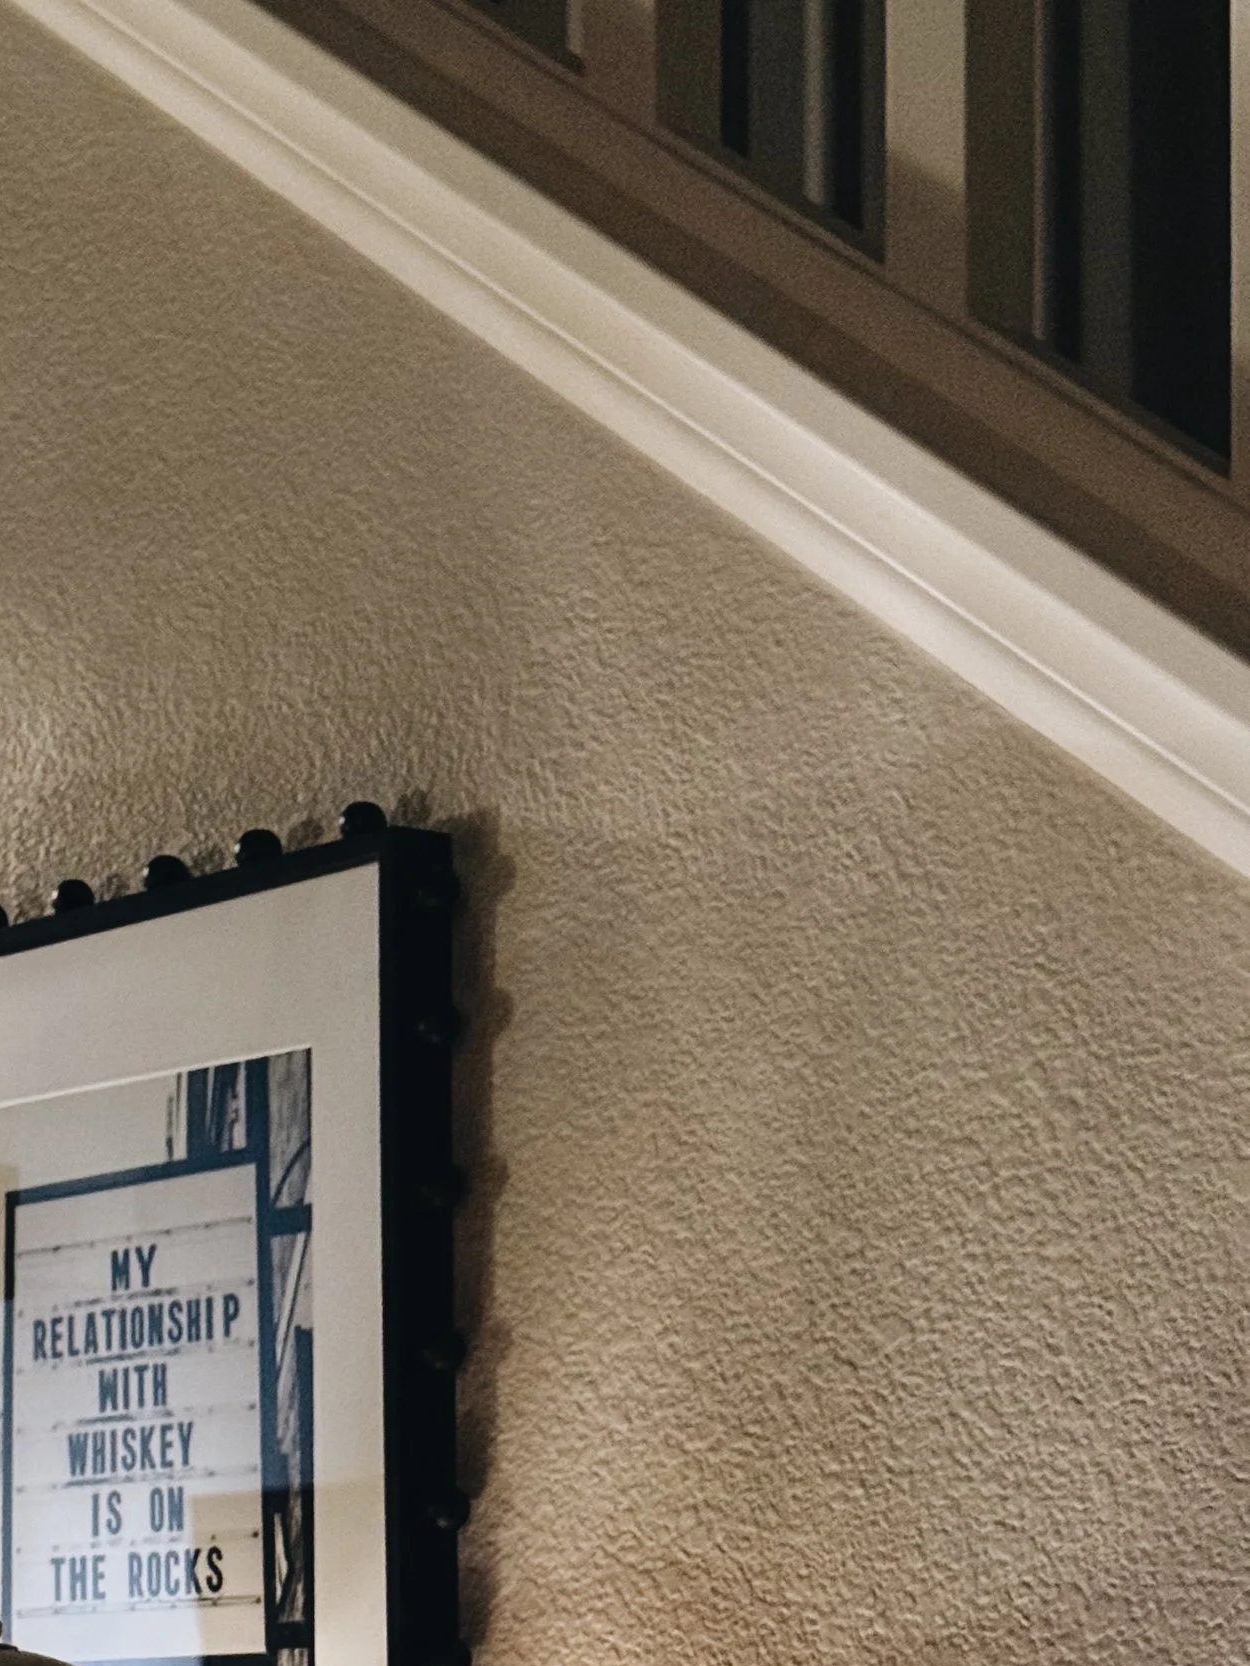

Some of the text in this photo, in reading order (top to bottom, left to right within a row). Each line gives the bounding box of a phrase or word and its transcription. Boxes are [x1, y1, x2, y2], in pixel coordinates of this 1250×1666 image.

[111, 1243, 157, 1291] MY
[33, 1294, 241, 1361] RELATIONSHIP
[98, 1363, 168, 1412] WITH
[68, 1421, 195, 1476] WHISKEY
[91, 1486, 185, 1537] IS ON
[50, 1546, 224, 1602] THE ROCKS
